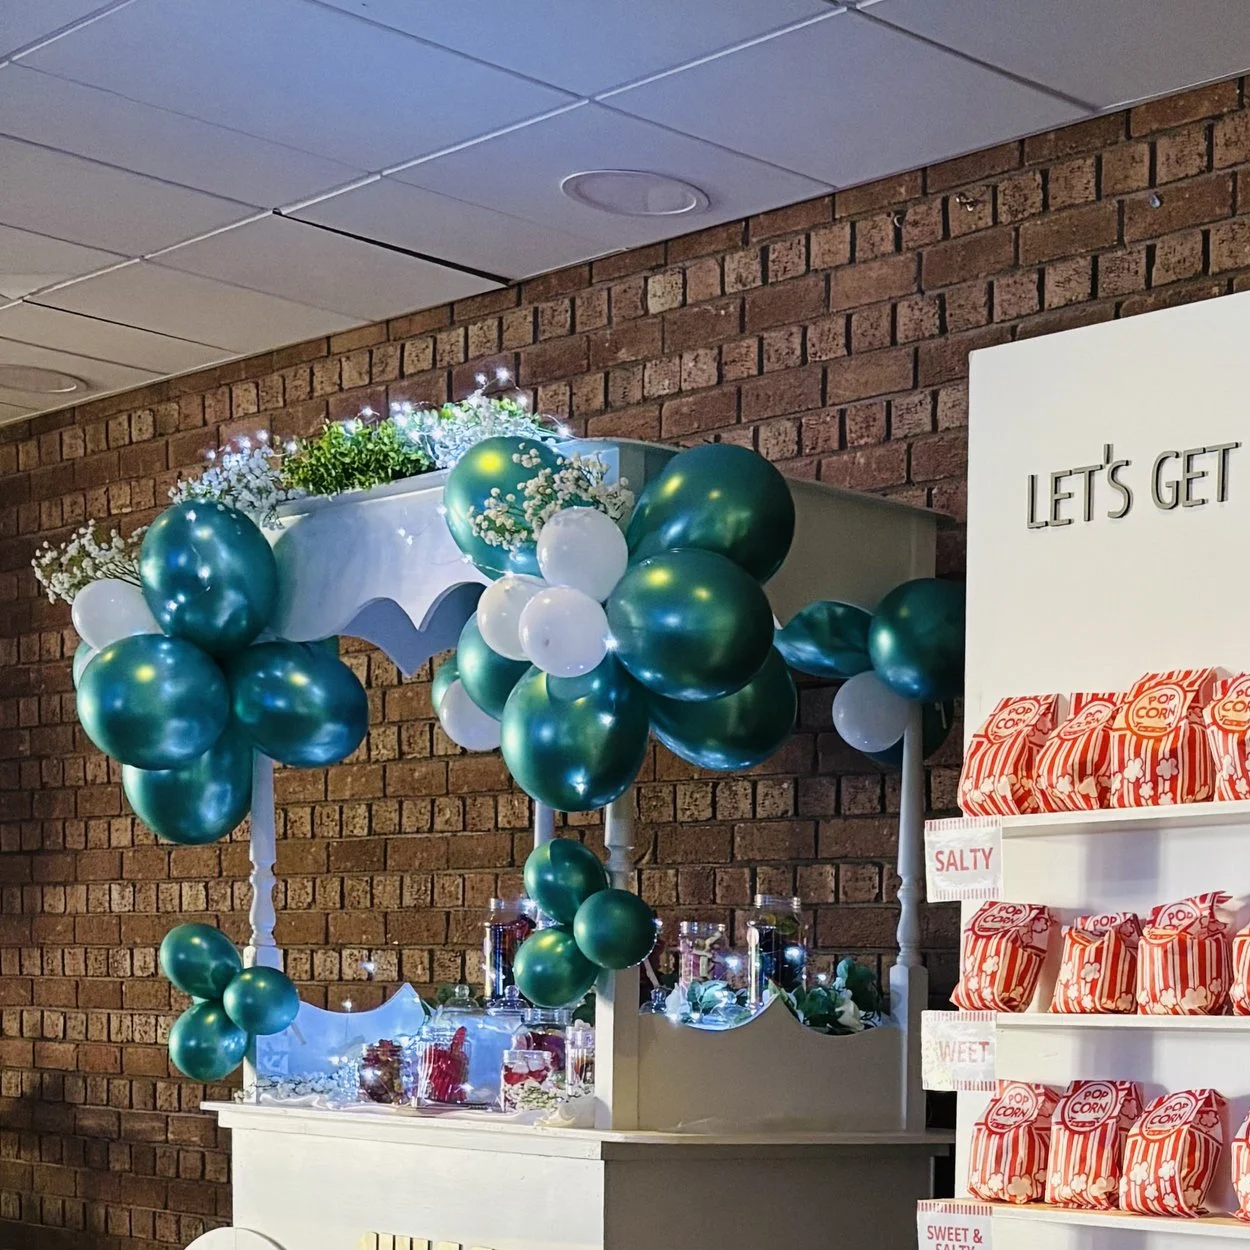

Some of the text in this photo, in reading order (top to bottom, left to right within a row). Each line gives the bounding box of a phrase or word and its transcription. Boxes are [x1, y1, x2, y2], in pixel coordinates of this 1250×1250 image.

[1027, 443, 1134, 529] LET'S
[1151, 442, 1242, 510] GET
[1148, 694, 1175, 704] POP
[1007, 706, 1032, 717] POP
[1136, 707, 1175, 718] CORN
[935, 847, 993, 872] SALTY
[999, 905, 1022, 915] POP
[1167, 910, 1193, 921] POP
[1093, 915, 1117, 928] POP
[1008, 1093, 1029, 1104] POP
[1084, 1090, 1108, 1100] POP
[996, 1106, 1028, 1118] CORN
[1071, 1102, 1108, 1113] CORN
[1164, 1102, 1188, 1113] POP
[1149, 1113, 1183, 1124] CORN
[927, 1225, 983, 1244] SWEET &
